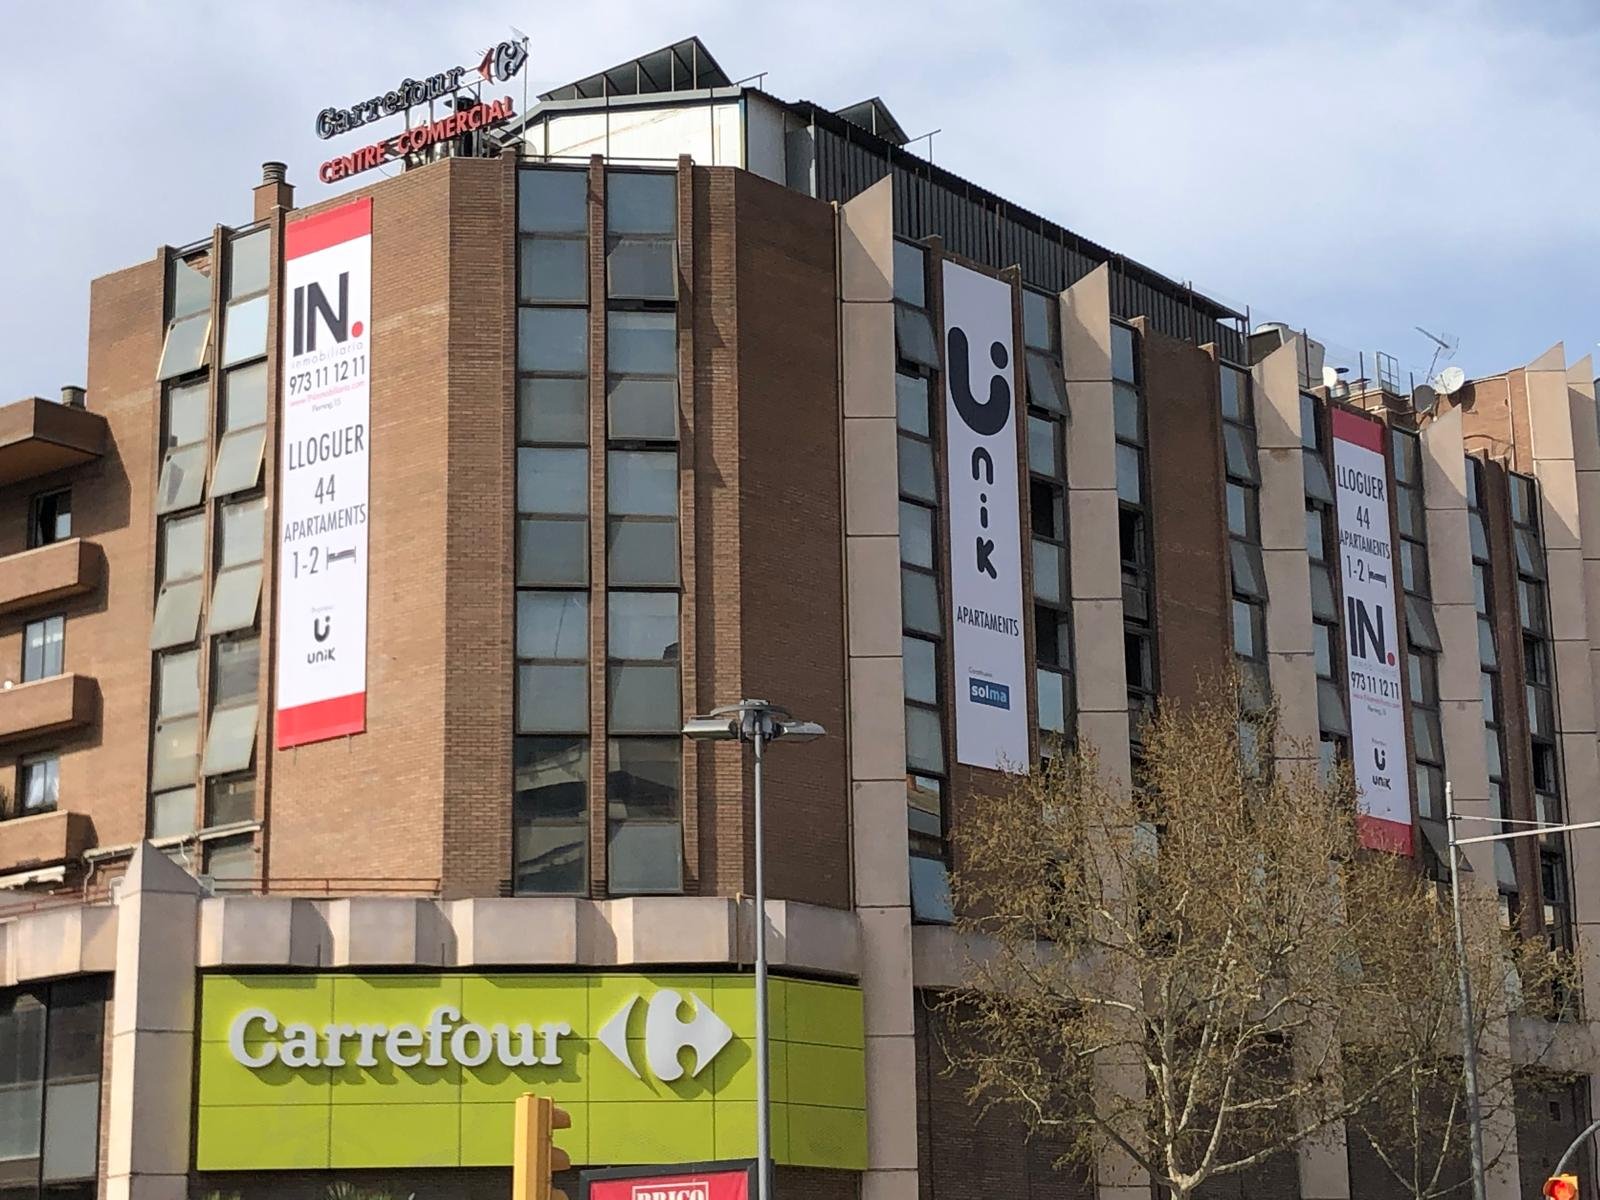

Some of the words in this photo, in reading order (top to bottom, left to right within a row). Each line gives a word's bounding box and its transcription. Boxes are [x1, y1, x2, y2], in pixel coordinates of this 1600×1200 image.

[316, 66, 466, 140] Carrefour
[319, 140, 388, 184] CENTRE
[395, 95, 515, 155] COMERCIAL
[289, 371, 312, 396] 973
[315, 366, 328, 388] 11
[334, 360, 349, 382] 12
[352, 355, 365, 377] 11
[289, 424, 364, 471] LLOGUER
[314, 473, 336, 504] 44
[1337, 464, 1385, 502] LLOGUER
[284, 503, 367, 543] APARTAMENTS
[1356, 505, 1370, 530] 44
[1339, 529, 1391, 560] APARTAMENTS
[293, 546, 319, 579] 1-2
[1347, 555, 1365, 582] 1-2
[957, 605, 1019, 637] APARTAMENTS
[971, 685, 1008, 703] solma
[1351, 671, 1365, 691] 973
[1367, 675, 1377, 694] 11
[1379, 678, 1389, 697] 12
[1390, 681, 1400, 700] 11
[228, 1005, 572, 1068] Carrefour
